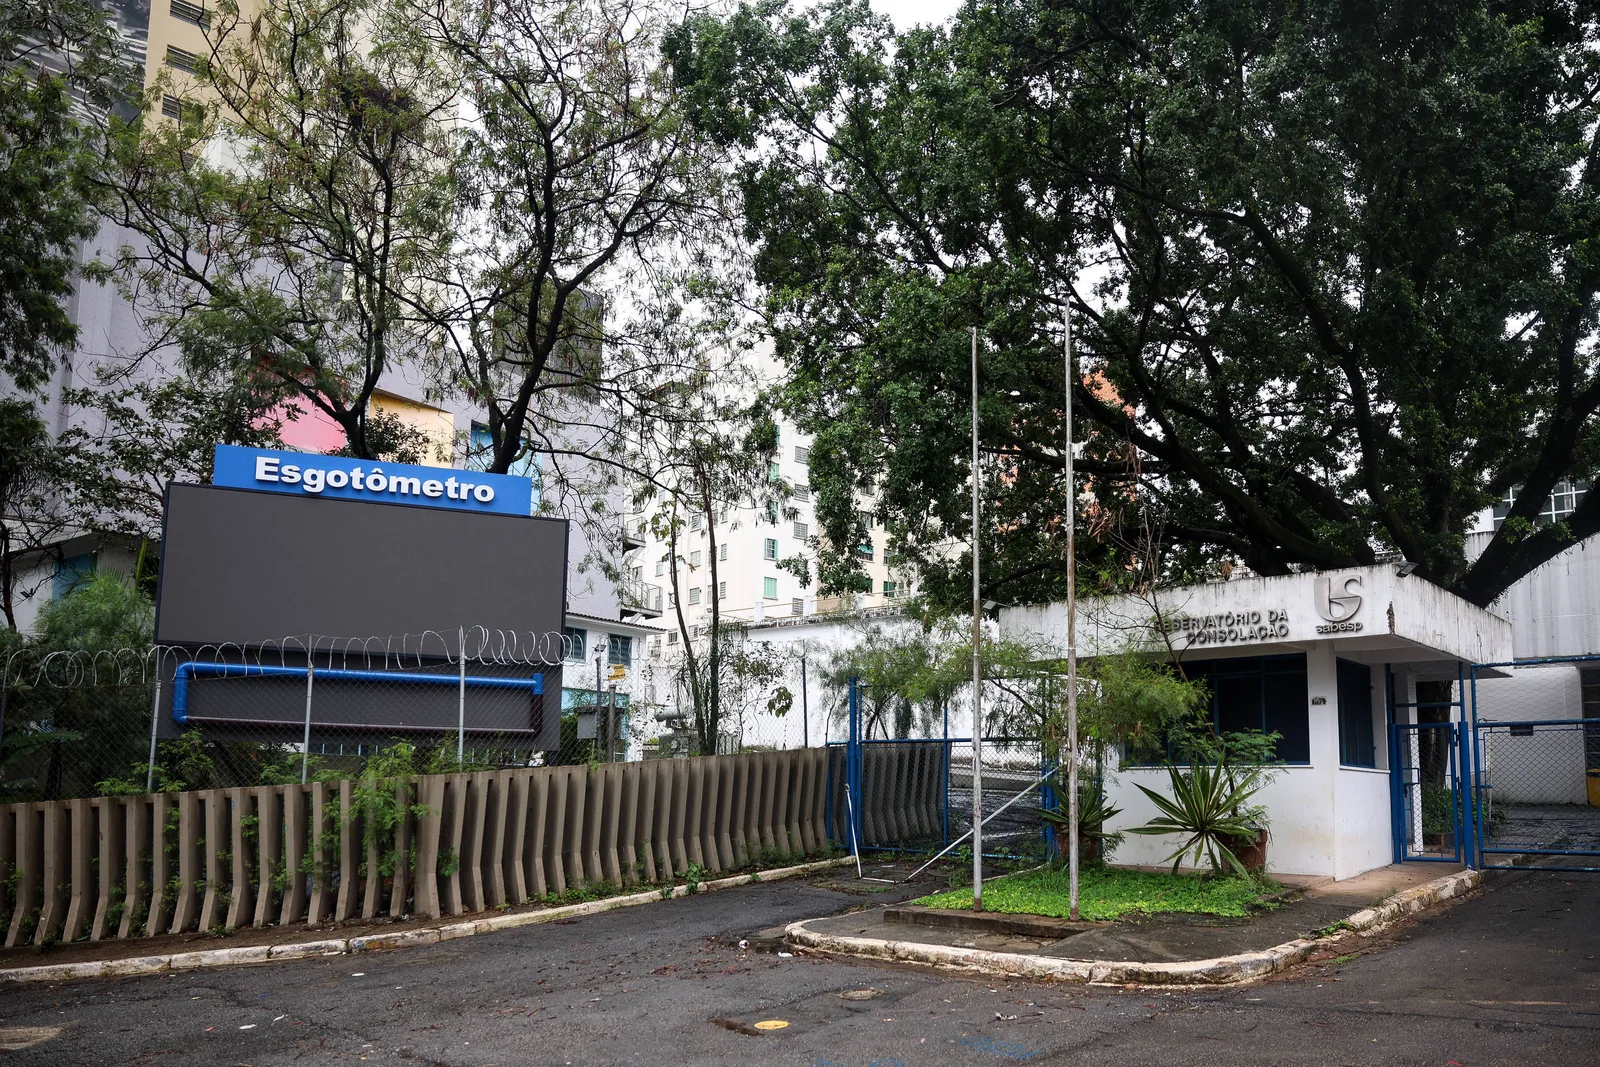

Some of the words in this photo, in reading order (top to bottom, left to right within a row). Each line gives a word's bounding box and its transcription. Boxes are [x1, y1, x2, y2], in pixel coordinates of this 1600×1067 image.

[255, 456, 495, 502] Esgotômetro
[1268, 608, 1288, 623] DA
[1186, 622, 1290, 645] CONSOLAÇÃO
[1315, 621, 1363, 634] sabesp
